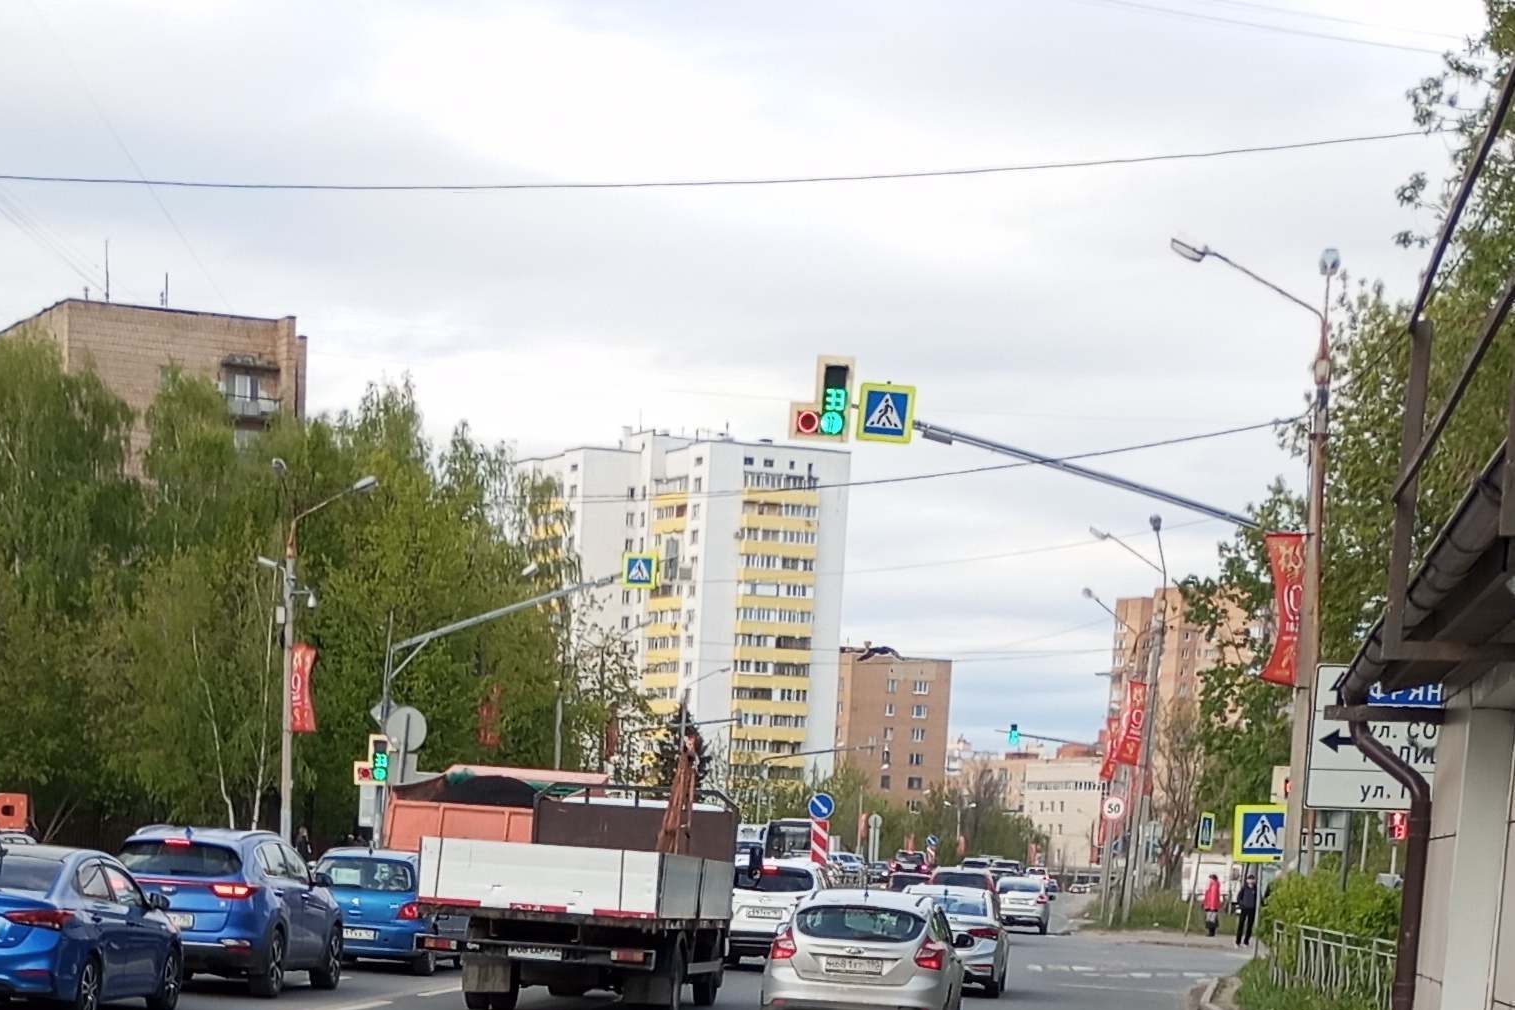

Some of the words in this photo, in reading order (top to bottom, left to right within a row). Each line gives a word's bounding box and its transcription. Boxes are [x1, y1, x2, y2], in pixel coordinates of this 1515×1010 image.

[1361, 784, 1391, 802] ул.
[1107, 803, 1121, 814] 50
[1301, 831, 1336, 848] ТОП
